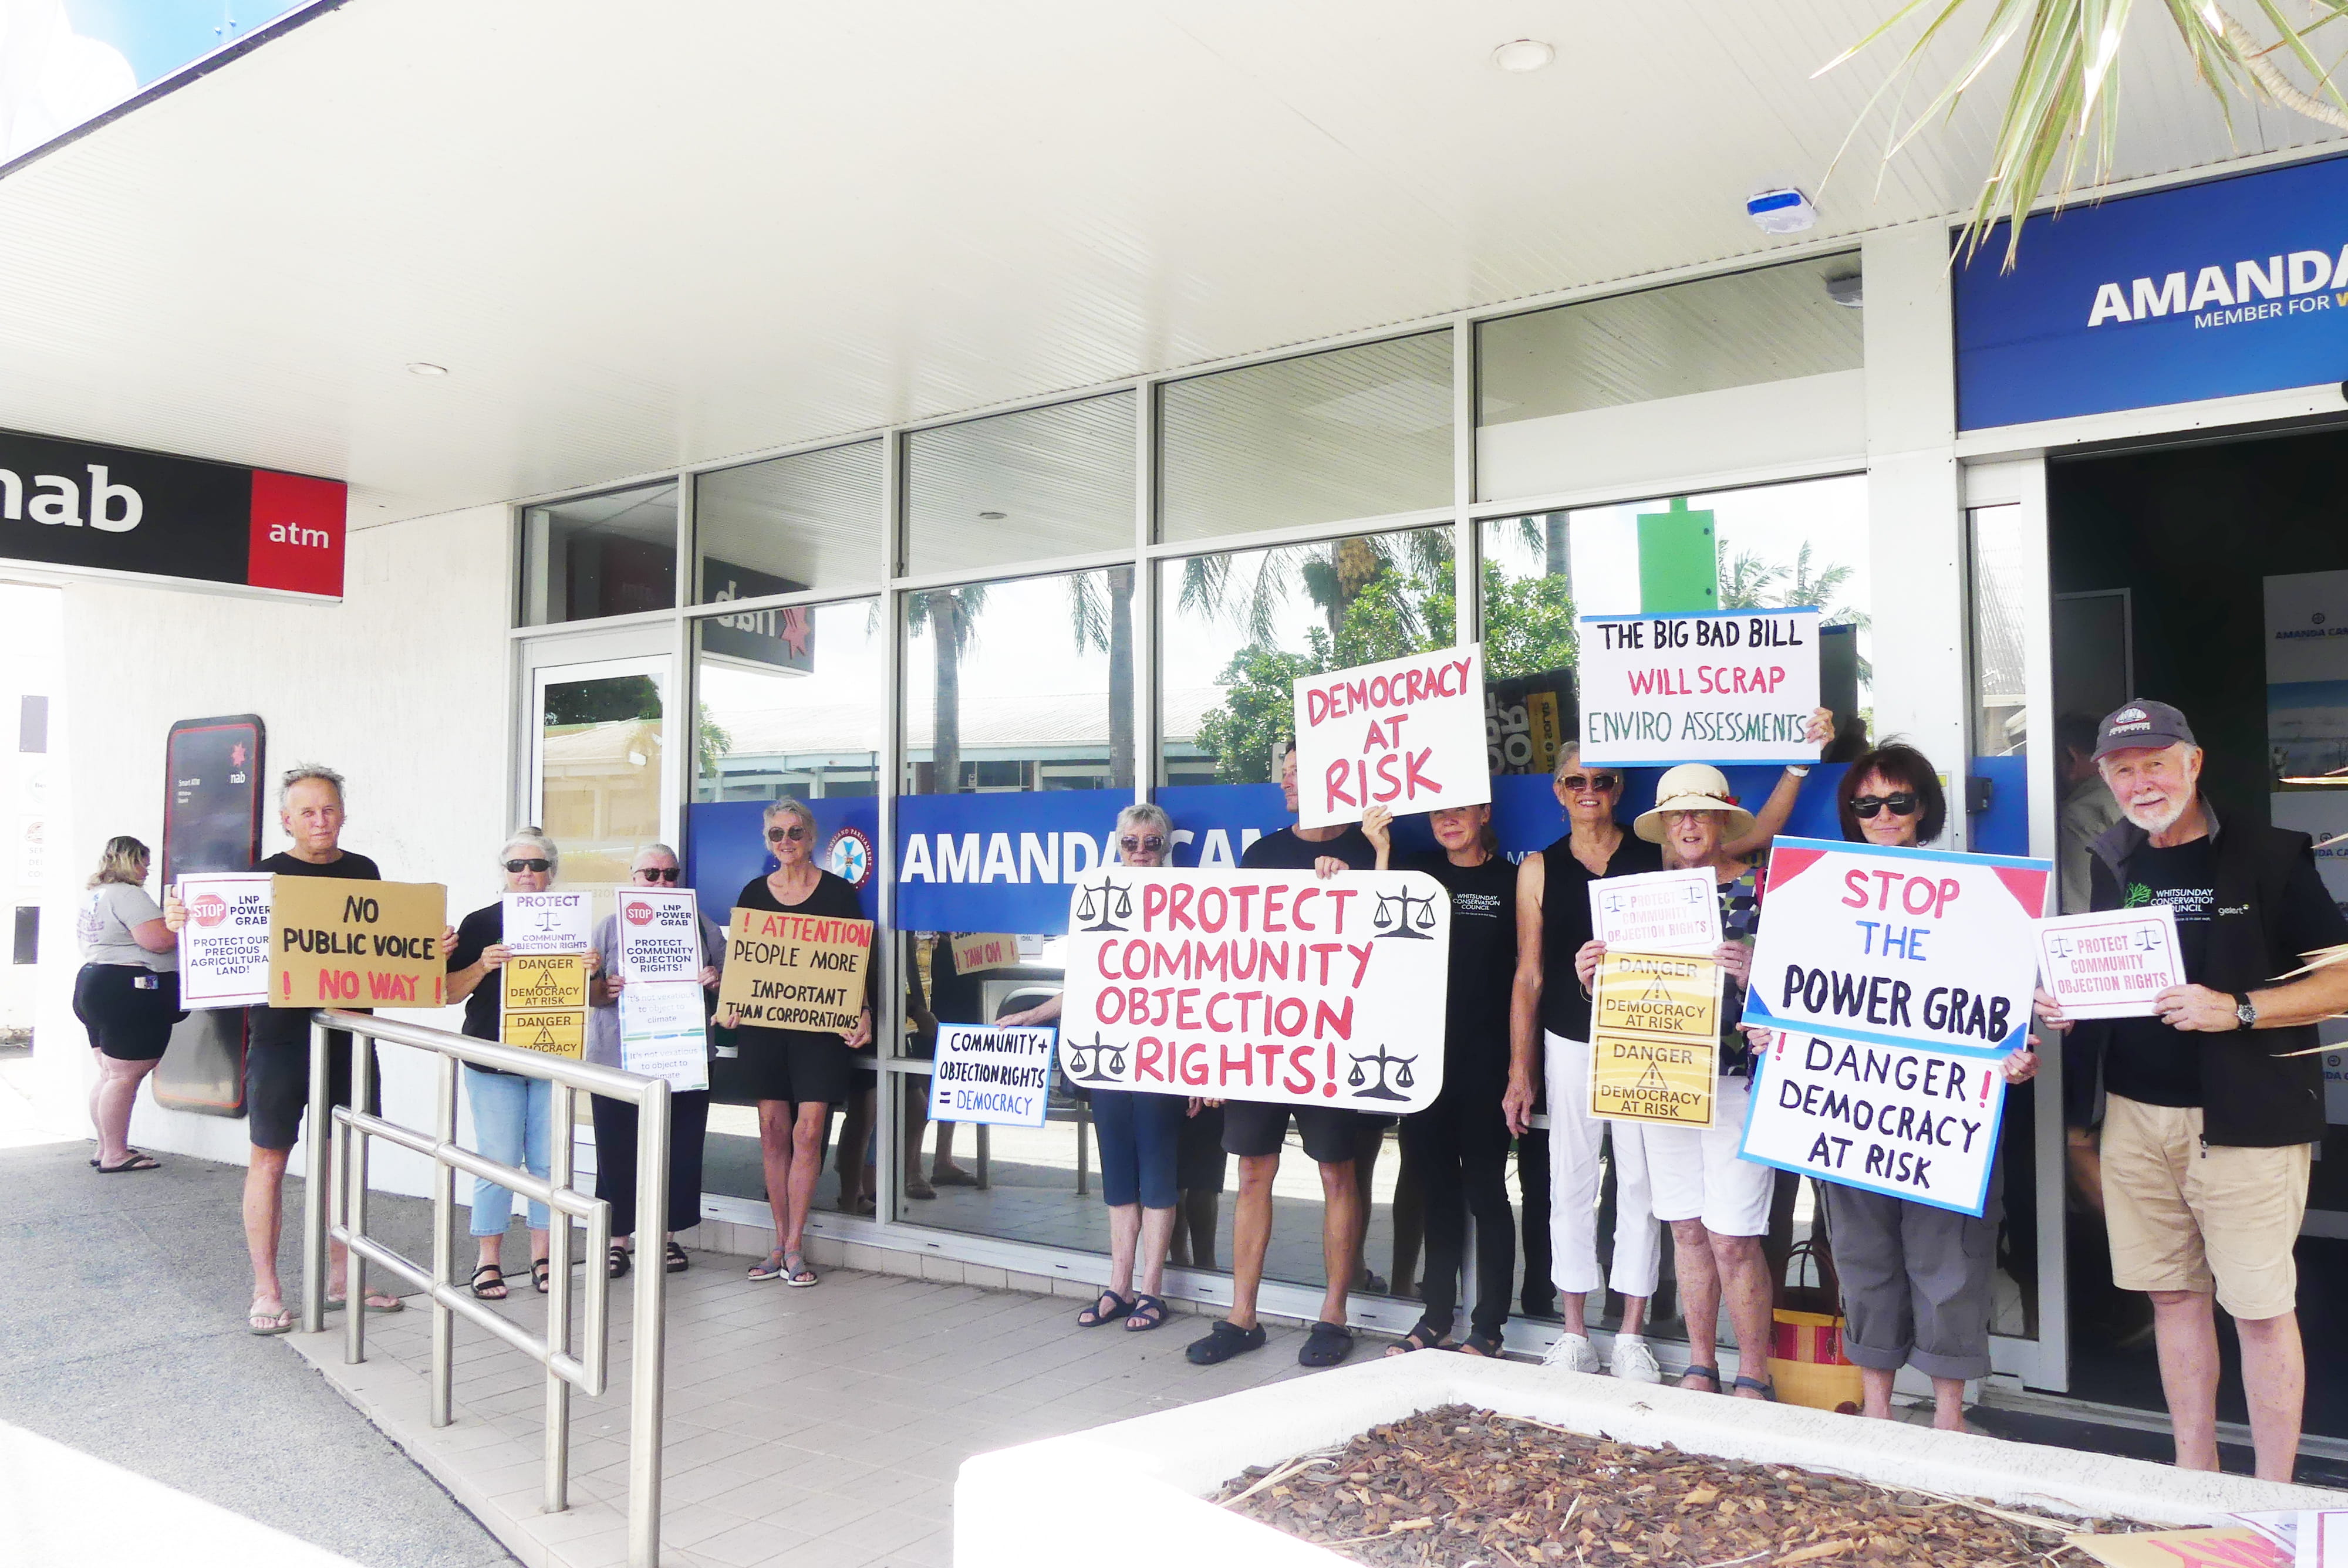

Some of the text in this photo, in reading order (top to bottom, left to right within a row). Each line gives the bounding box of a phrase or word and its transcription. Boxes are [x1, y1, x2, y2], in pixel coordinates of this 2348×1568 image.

[2195, 302, 2282, 328] MEMBER
[2289, 295, 2330, 315] FOR
[269, 522, 329, 549] atm
[1597, 619, 1803, 649] THE BIG BAD BILL
[1628, 666, 1786, 695] WILL SCRAP
[1307, 657, 1472, 727] DEMOCRACY
[1363, 714, 1409, 754] AT
[1588, 712, 1807, 744] ENVIRO ASSESSMENTS
[230, 771, 246, 783] nab
[1326, 746, 1442, 813] RISK
[851, 829, 872, 866] PARLIAMENT
[239, 895, 259, 904] LNP
[517, 895, 580, 907] PROTECT
[1631, 891, 1675, 909] PROTECT
[1841, 869, 1959, 919] STOP
[2151, 896, 2214, 906] CONSERVATION
[2156, 888, 2214, 898] WHITSUNDAY
[194, 904, 224, 917] STOP
[230, 905, 270, 915] POWER
[343, 895, 379, 923] NO
[628, 908, 652, 919] STOP
[1142, 883, 1358, 934] PROTECT
[1622, 905, 1688, 925] COMMUNITY
[2172, 904, 2202, 913] UNCIL
[2218, 906, 2244, 916] gelert
[235, 916, 268, 925] GRAB
[194, 936, 269, 947] PROTECT OUR
[522, 934, 576, 942] COMMUNITY
[761, 915, 872, 948] ATTENTION
[1608, 920, 1706, 943] OBJECTION RIGHTS
[1856, 920, 1931, 961] THE
[205, 945, 259, 957] PRECIOUS
[284, 928, 436, 959] PUBLIC VOICE
[510, 941, 588, 950] OBJECTION RIGHTS
[627, 947, 694, 955] COMMUNITY
[2077, 935, 2128, 955] PROTECT
[191, 955, 269, 967] AGRICULTURA
[518, 959, 573, 969] DANGER
[630, 955, 691, 964] OBJECTION
[734, 939, 859, 972] PEOPLE MORE
[1098, 938, 1374, 989] COMMUNITY
[2070, 952, 2144, 975] COMMUNITY
[217, 965, 249, 975] LAND!
[640, 964, 683, 973] RIGHTS!
[1619, 958, 1698, 978] DANGER
[319, 969, 360, 999] NO
[368, 971, 419, 1001] WAY
[511, 987, 579, 998] DEMOCRACY
[751, 979, 847, 1007] IMPORTANT
[2057, 972, 2168, 994] OBJECTION RIGHTS
[525, 996, 565, 1006] AT RISK
[649, 1005, 674, 1013] object
[1606, 999, 1706, 1019] DEMOCRACY
[1782, 964, 2010, 1043] POWER GRAB
[517, 1016, 571, 1027] DANGER
[647, 1015, 677, 1023] climate
[726, 1002, 859, 1030] THAN CORPORATIONS
[1095, 986, 1354, 1040] OBJECTION
[1625, 1015, 1683, 1030] AT RISK
[517, 1043, 577, 1053] OCRACY
[660, 1048, 699, 1057] vexatious
[1614, 1043, 1693, 1065] DANGER
[652, 1061, 677, 1070] object
[940, 1061, 1045, 1089] OBJECTION RIGHTS
[1133, 1036, 1338, 1098] RIGHTS!
[1805, 1037, 1966, 1101] DANGER
[957, 1090, 1033, 1116] DEMOCRACY
[1601, 1084, 1702, 1106] DEMOCRACY
[1621, 1100, 1679, 1117] AT RISK
[1779, 1079, 1981, 1153] DEMOCRACY
[1808, 1133, 1932, 1189] AT RISK
